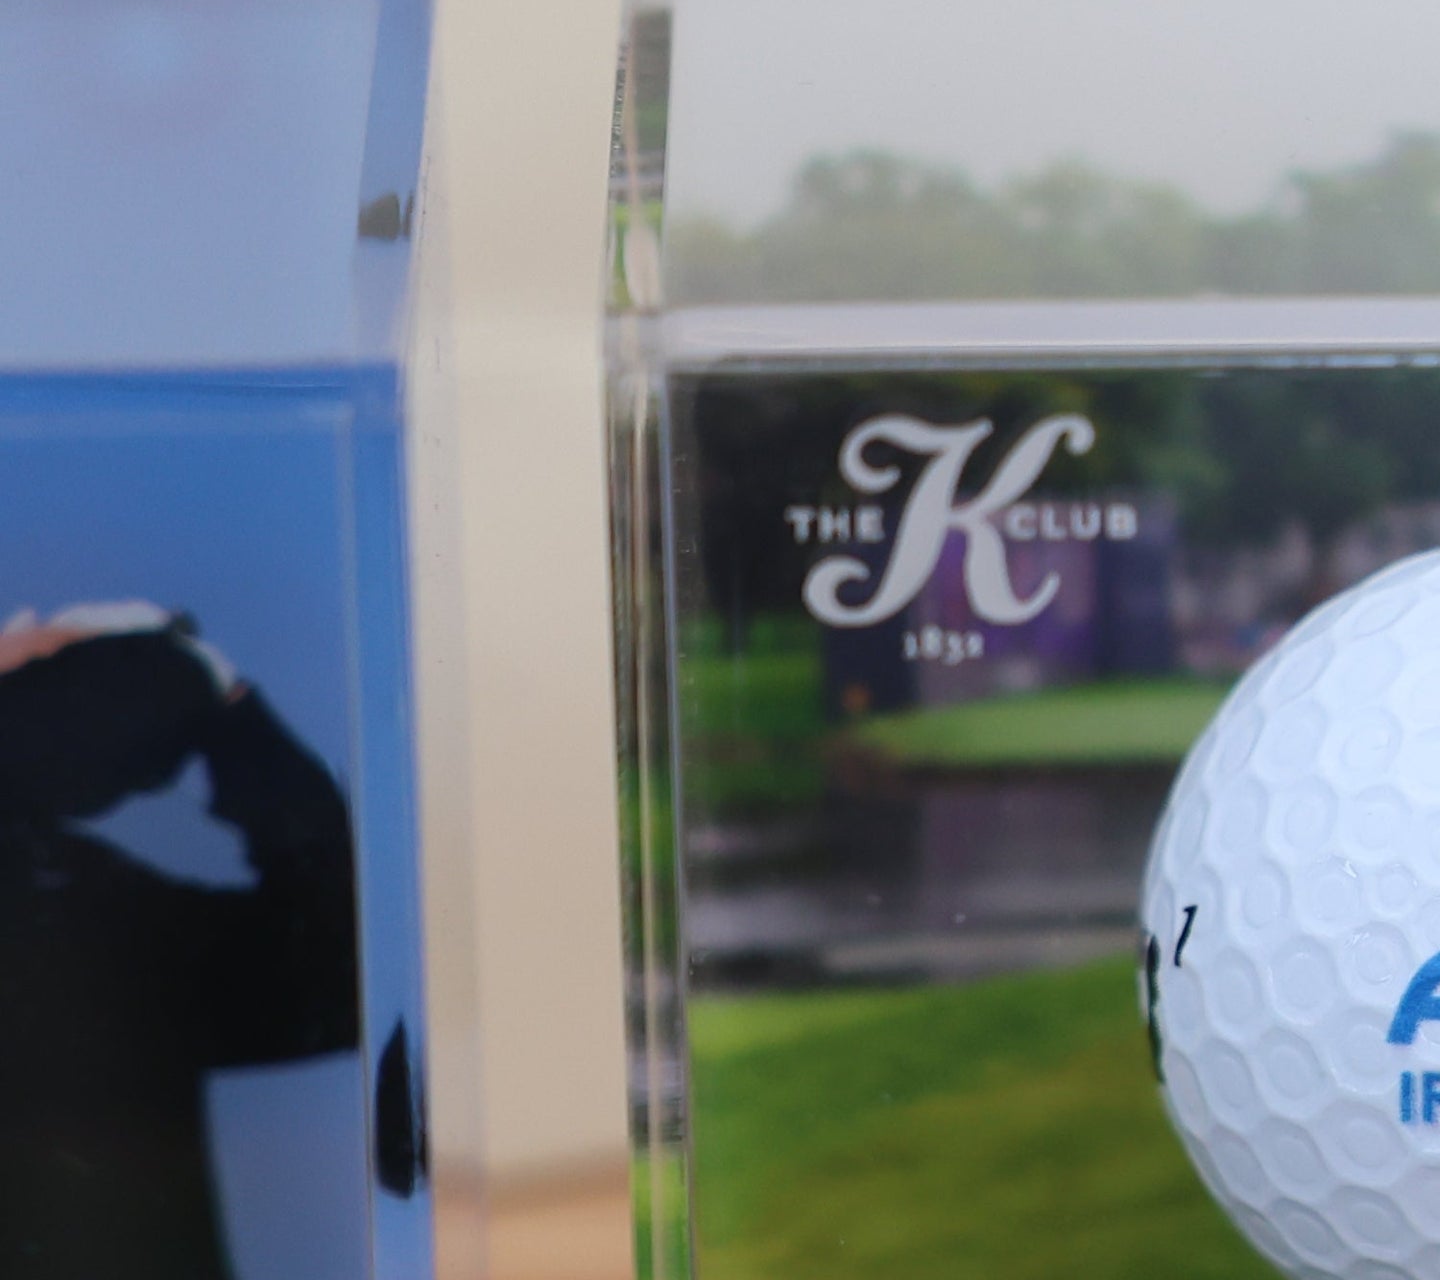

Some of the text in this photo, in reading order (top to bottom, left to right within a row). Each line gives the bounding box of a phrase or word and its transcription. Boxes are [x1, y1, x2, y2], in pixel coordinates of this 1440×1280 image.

[785, 413, 1139, 628] THE K CLUB
